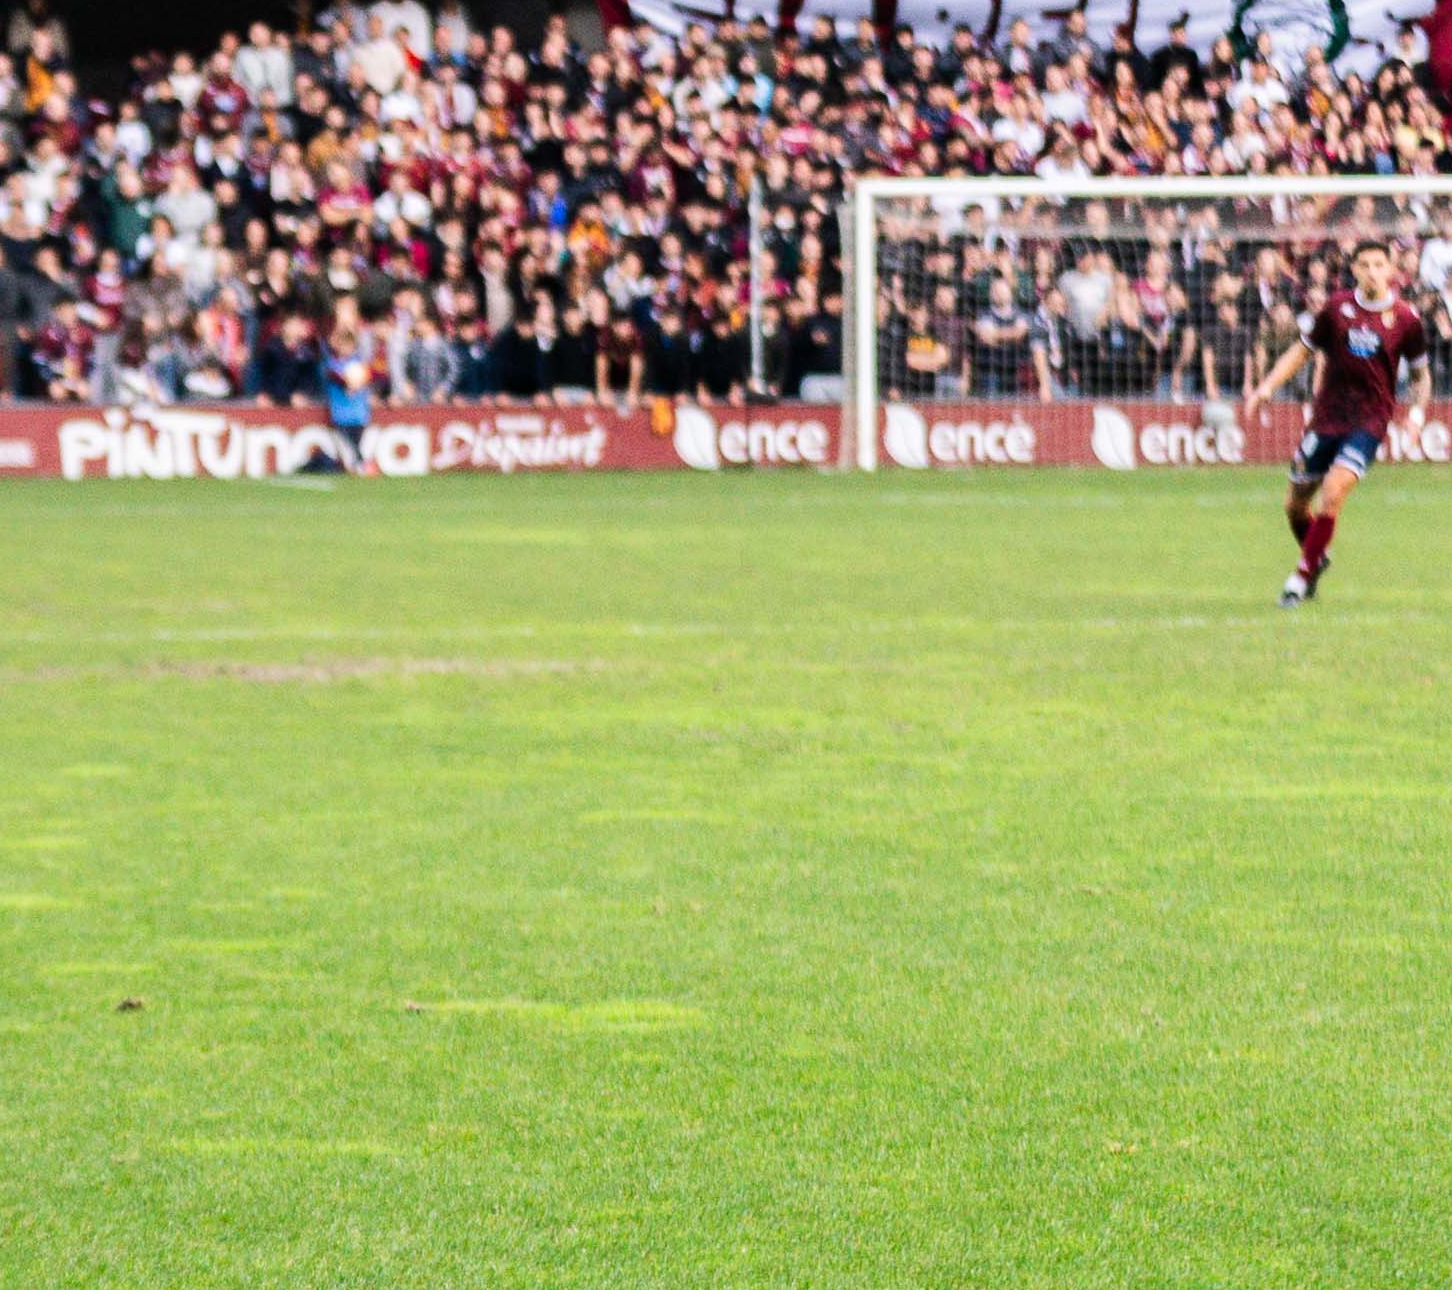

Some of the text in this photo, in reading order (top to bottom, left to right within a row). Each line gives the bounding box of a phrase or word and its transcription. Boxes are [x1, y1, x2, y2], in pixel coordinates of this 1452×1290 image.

[718, 415, 829, 464] ence
[927, 417, 1036, 464] ence
[1139, 421, 1246, 464] ence
